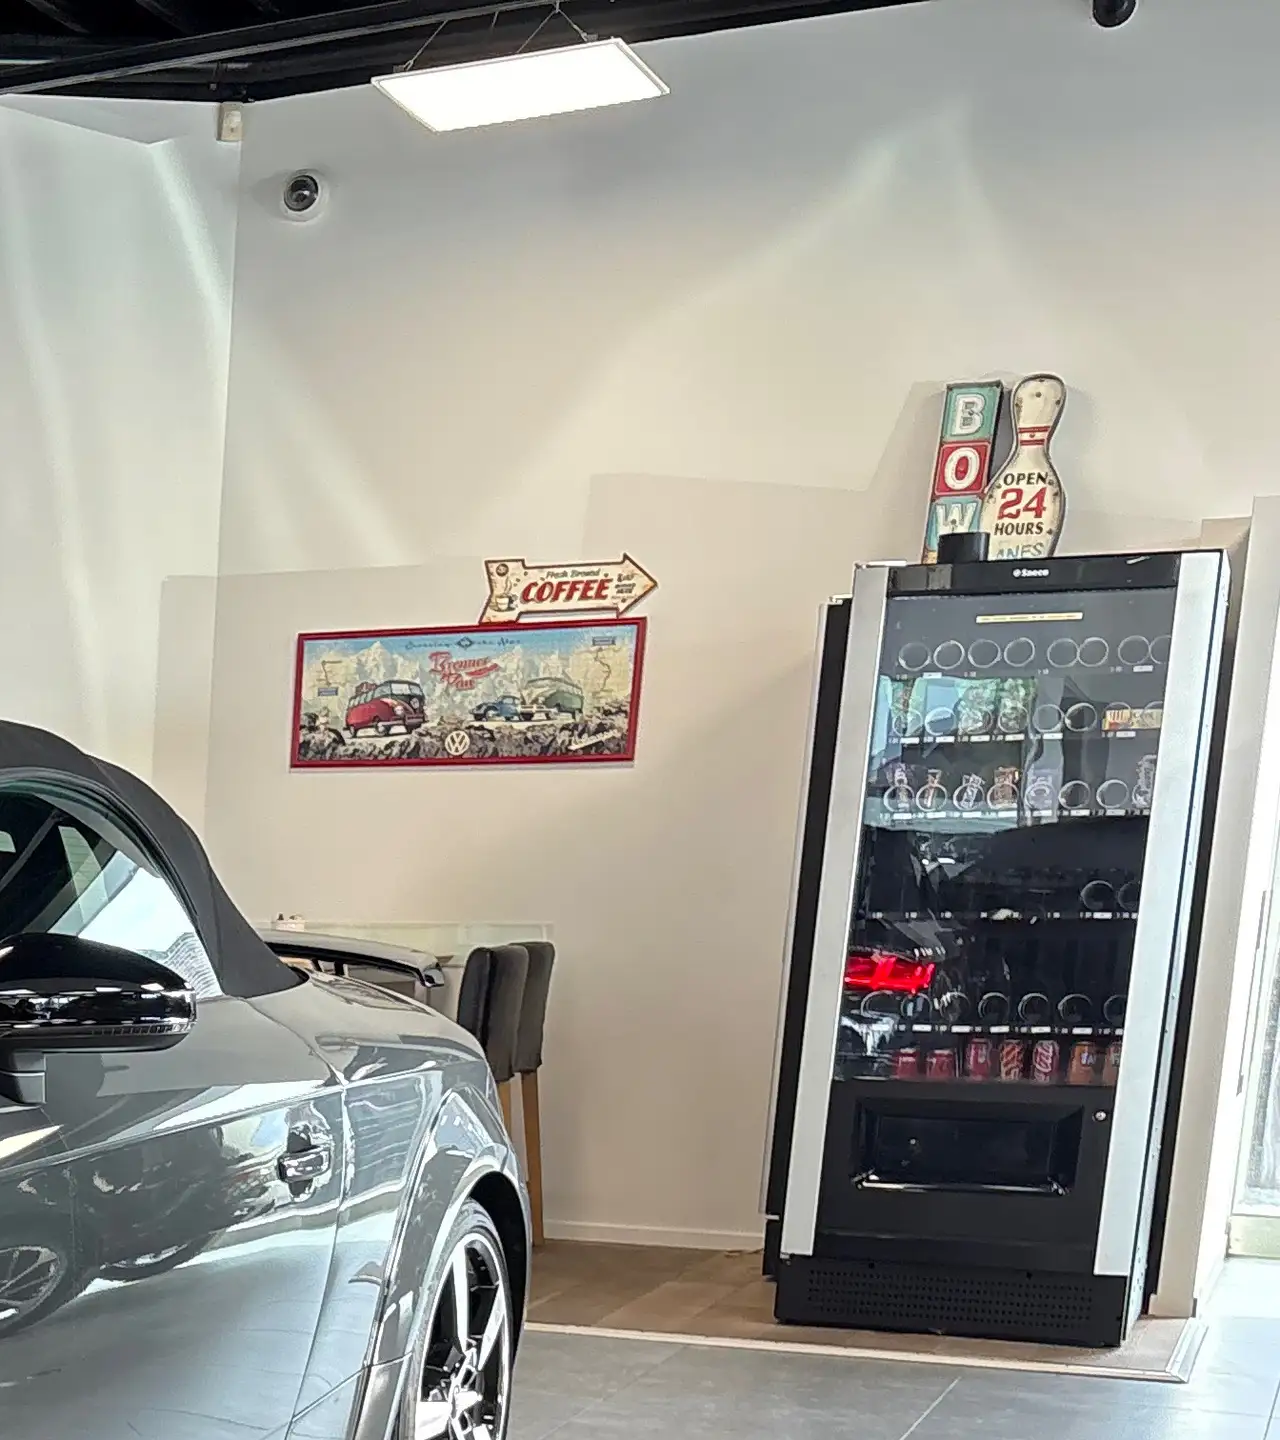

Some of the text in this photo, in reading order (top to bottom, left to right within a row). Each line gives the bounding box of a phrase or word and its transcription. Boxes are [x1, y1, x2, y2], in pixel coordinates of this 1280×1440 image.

[934, 393, 986, 533] BOW
[1003, 472, 1049, 487] OPEN
[997, 487, 1048, 521] 24
[994, 522, 1044, 537] HOURS
[520, 577, 614, 605] COFFEE
